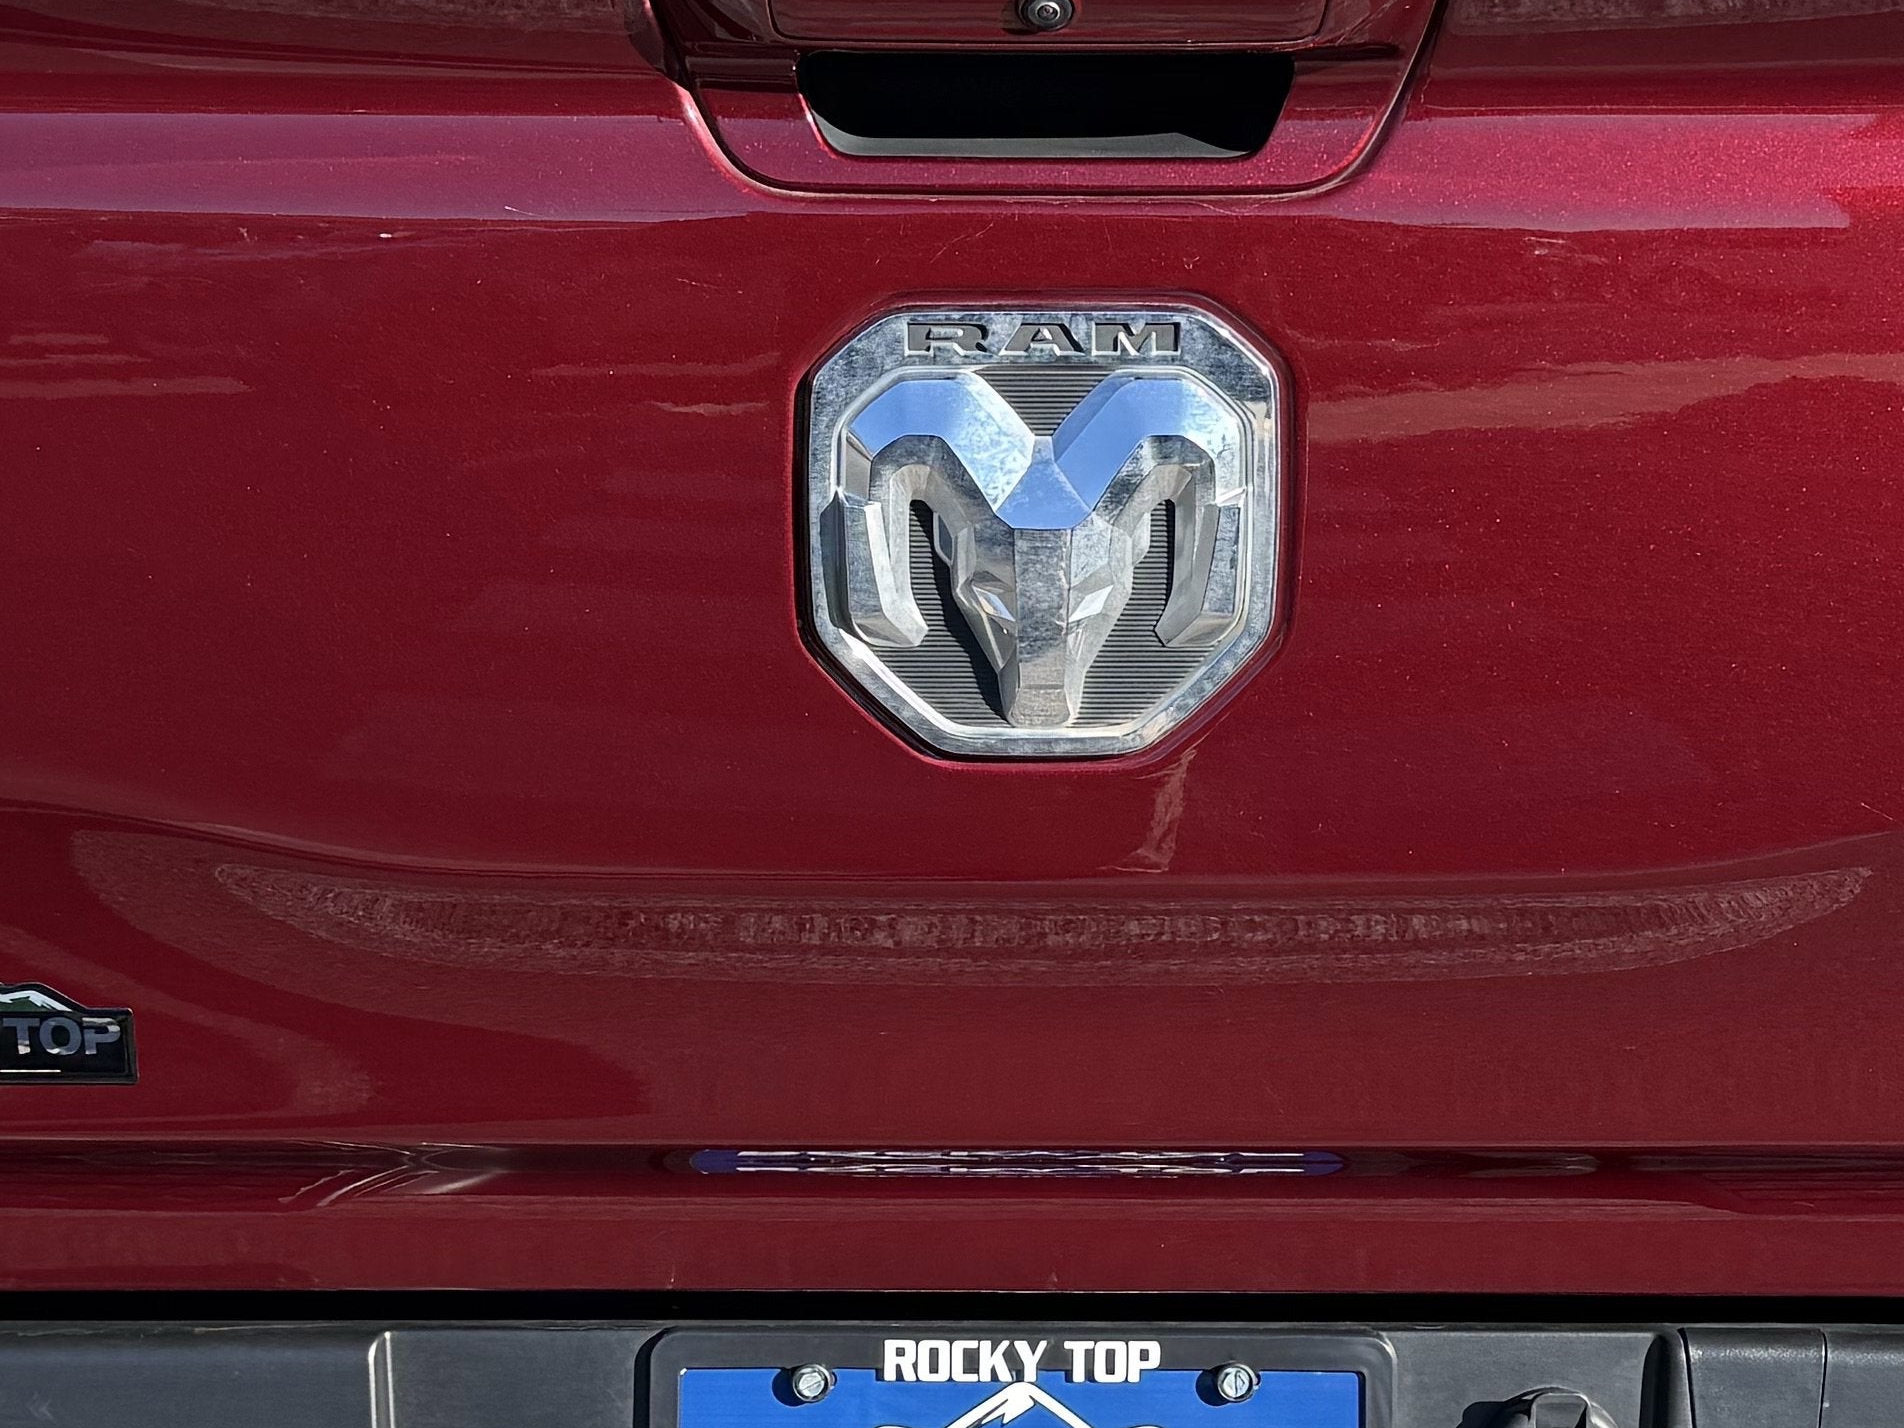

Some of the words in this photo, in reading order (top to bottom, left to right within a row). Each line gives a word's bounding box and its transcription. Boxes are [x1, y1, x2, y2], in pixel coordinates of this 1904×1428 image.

[904, 321, 1183, 357] RAM
[2, 1016, 122, 1056] TOP
[882, 1338, 1048, 1383] ROCKY
[1063, 1339, 1162, 1384] TOP
